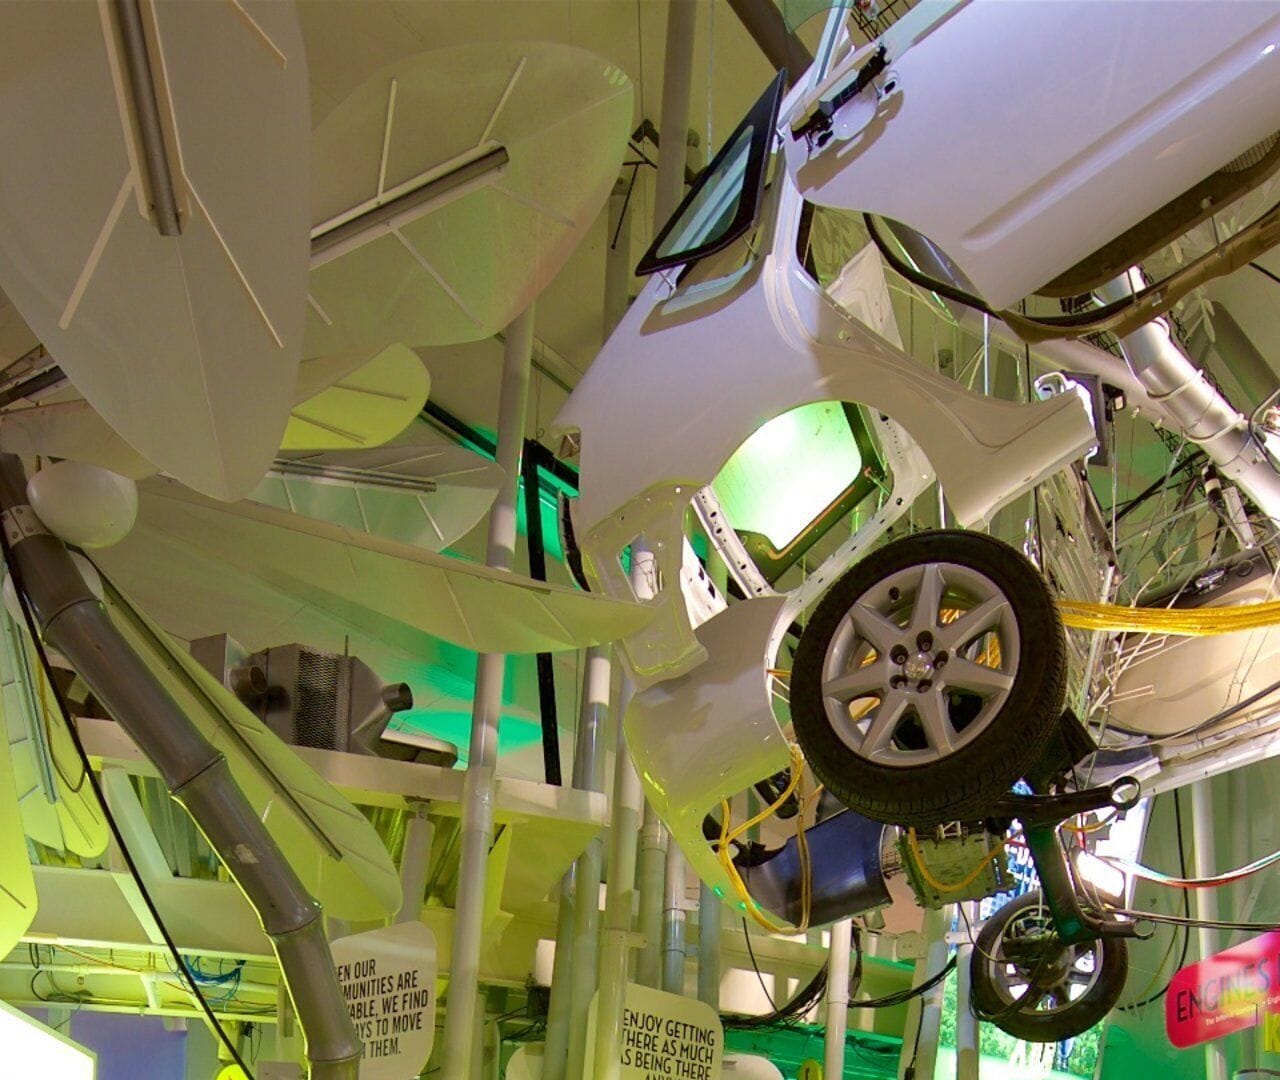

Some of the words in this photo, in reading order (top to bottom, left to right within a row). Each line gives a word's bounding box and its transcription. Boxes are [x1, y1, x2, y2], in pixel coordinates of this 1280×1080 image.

[338, 964, 350, 982] EN
[354, 959, 376, 979] OUR
[343, 975, 394, 1000] MUNITIES
[397, 970, 418, 990] ARE
[1177, 958, 1270, 1023] ENGINES
[382, 995, 399, 1015] WE
[402, 989, 428, 1011] FIND
[376, 1018, 388, 1036] TO
[392, 1012, 422, 1034] MOVE
[623, 1009, 663, 1032] ENJOY
[665, 1019, 715, 1047] GETTING
[635, 1052, 671, 1074] BEING
[661, 1039, 676, 1057] AS
[680, 1042, 714, 1065] MUCH
